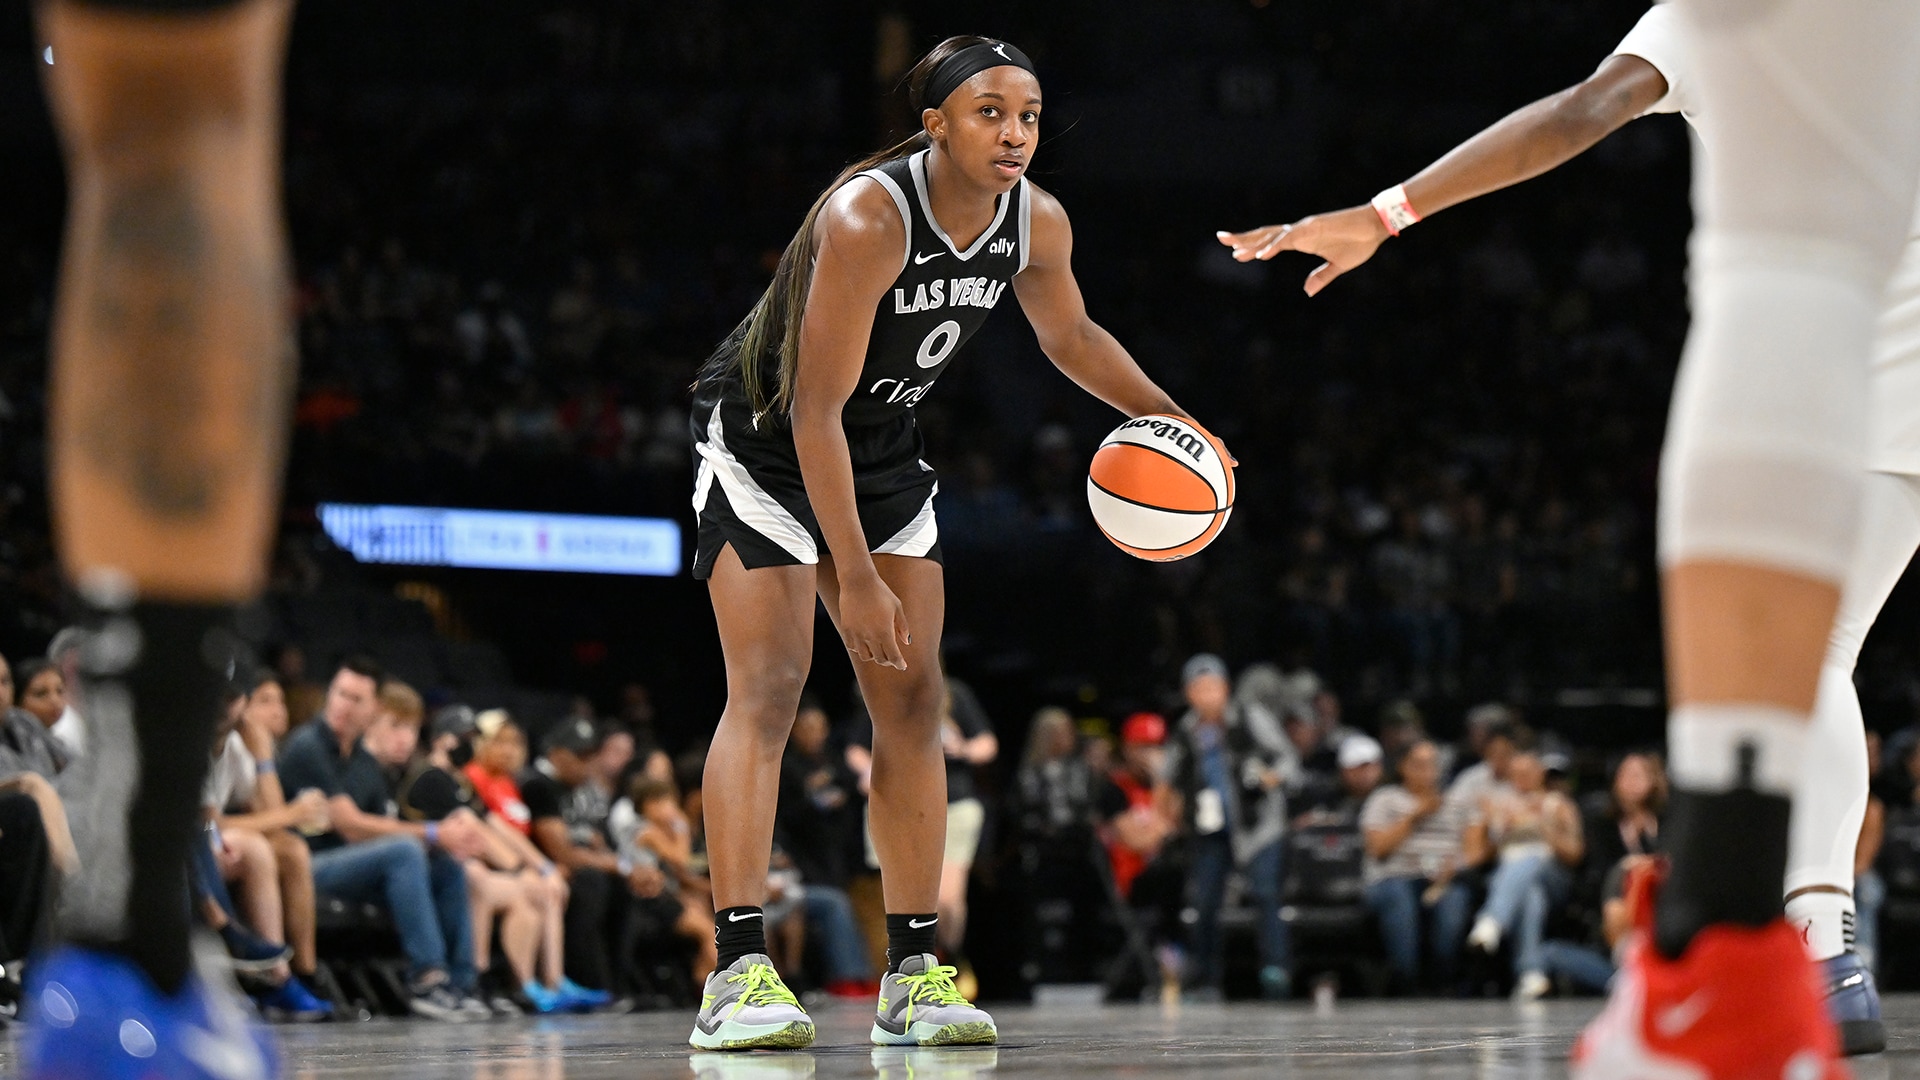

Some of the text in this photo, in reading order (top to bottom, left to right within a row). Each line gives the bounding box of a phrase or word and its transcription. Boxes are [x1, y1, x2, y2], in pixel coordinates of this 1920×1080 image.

[989, 238, 1016, 258] ally
[895, 279, 945, 314] LAS
[916, 320, 961, 369] 0
[870, 377, 935, 408] ring
[1120, 419, 1205, 462] Wilson
